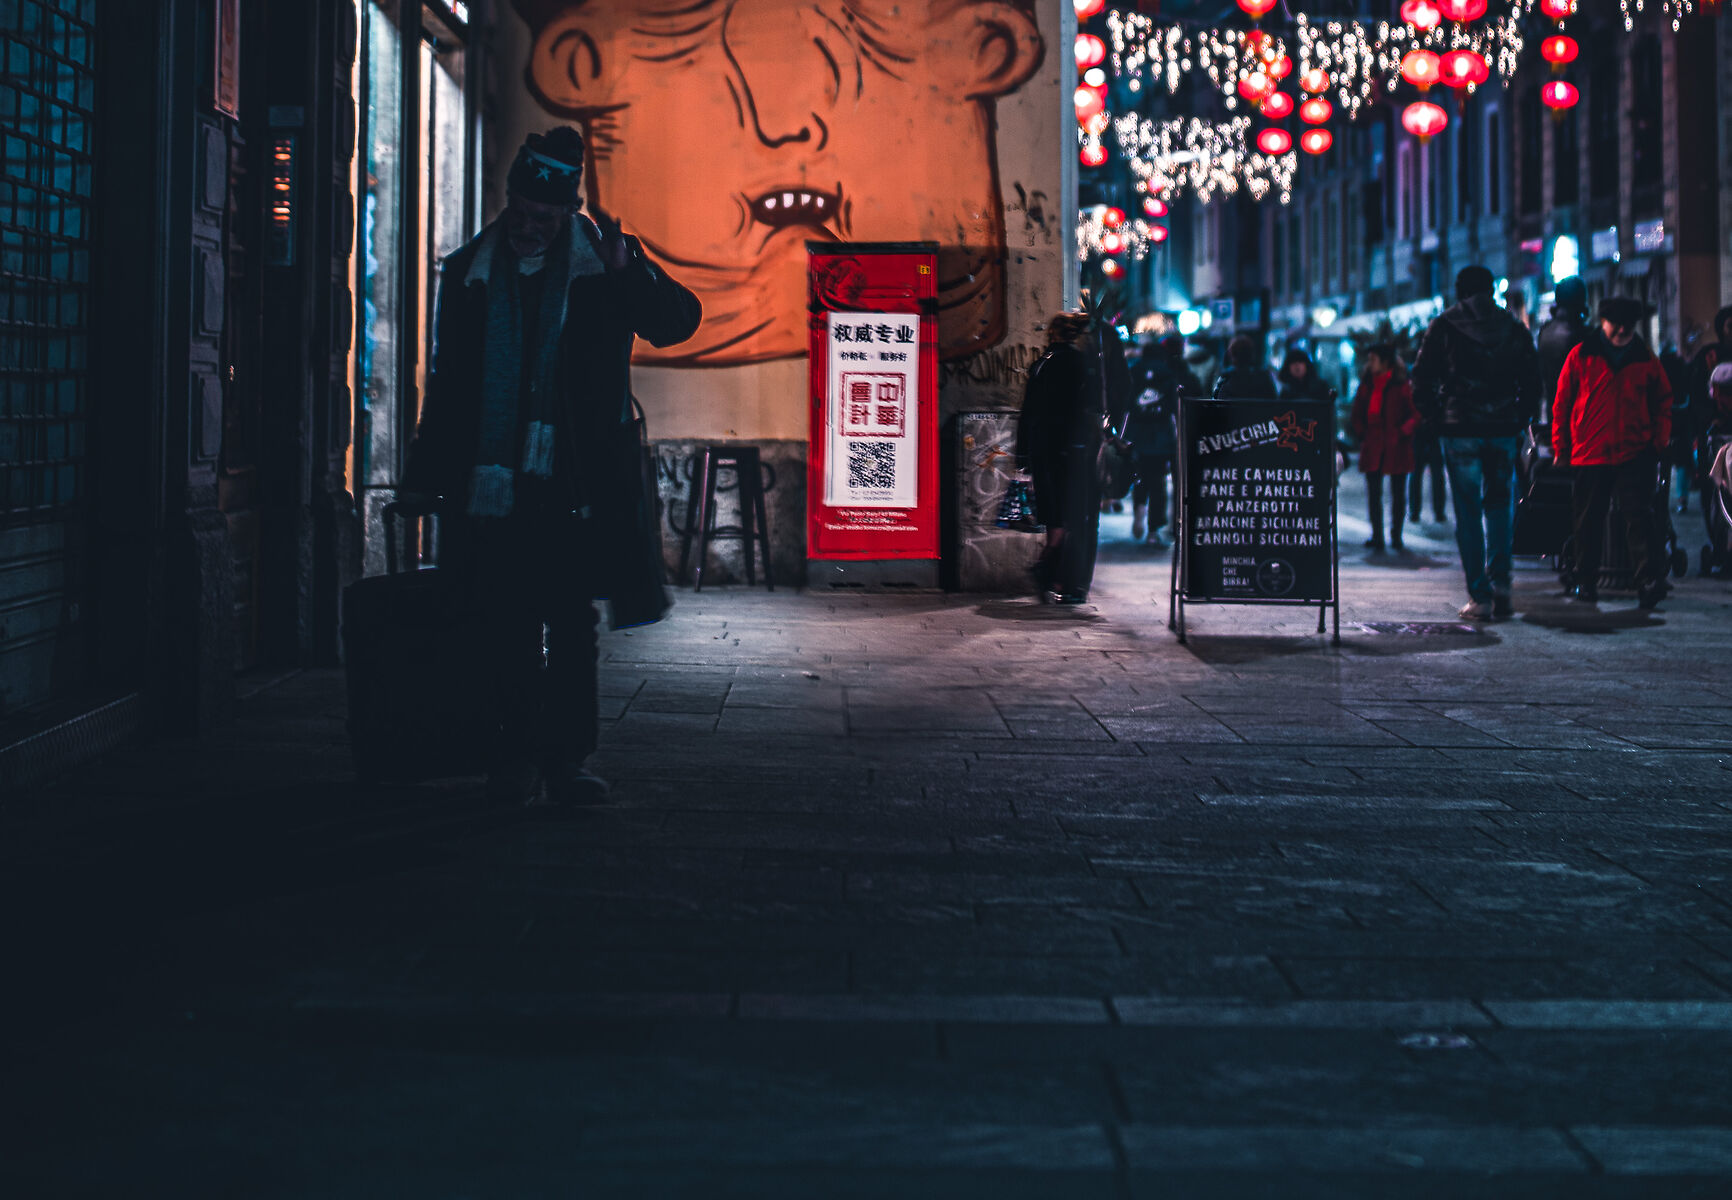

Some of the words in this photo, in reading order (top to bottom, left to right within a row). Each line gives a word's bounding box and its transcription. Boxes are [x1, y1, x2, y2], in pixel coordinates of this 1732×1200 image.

[833, 323, 915, 344] 权威专业
[1203, 468, 1238, 481] PANE
[1244, 468, 1312, 481] CA'MEUSA
[1201, 484, 1235, 498] PANE
[1241, 485, 1249, 497] E
[1255, 484, 1315, 497] PANELLE
[1216, 501, 1300, 513] PANZEROTTI
[1197, 516, 1256, 530] ARANCINE
[1261, 516, 1320, 530] SICILIANE
[1195, 532, 1253, 546] CANNOLI
[1259, 533, 1322, 547] SICILIANI
